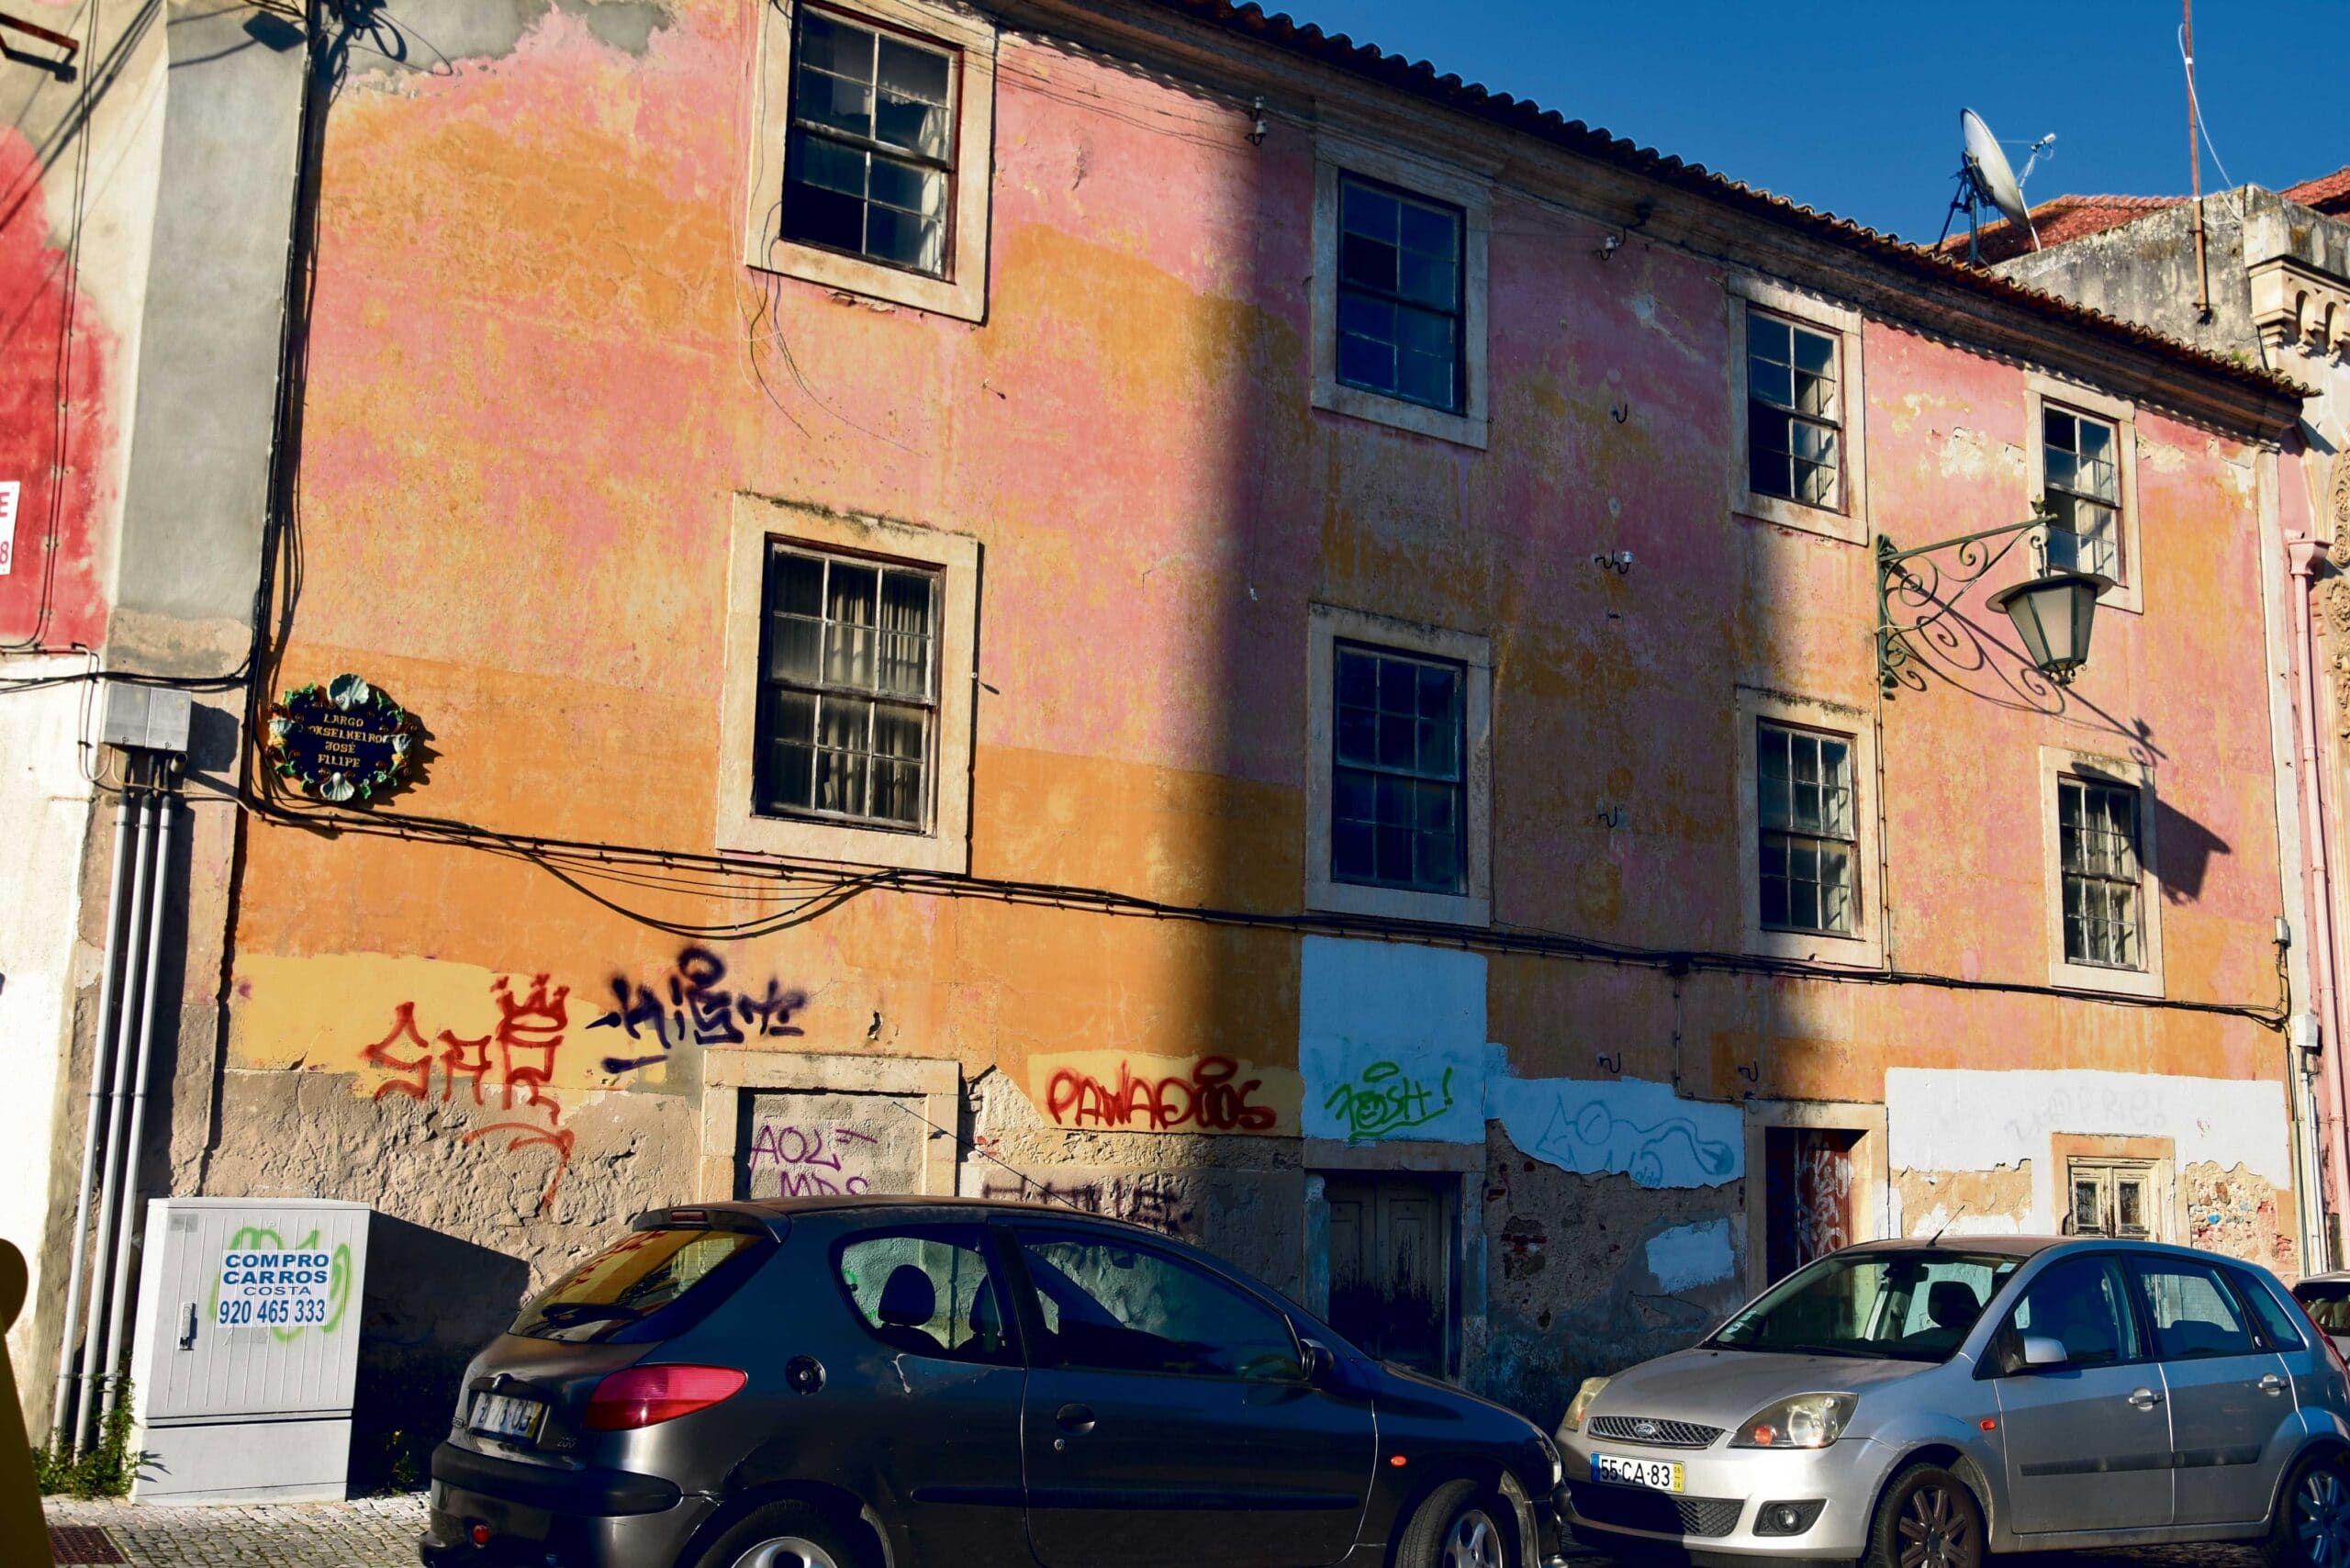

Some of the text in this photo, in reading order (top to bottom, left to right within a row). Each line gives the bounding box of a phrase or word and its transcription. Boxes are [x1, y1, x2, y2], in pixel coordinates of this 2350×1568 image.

[323, 713, 364, 727] LARGO
[325, 741, 356, 754] JOSÉ
[318, 754, 360, 767] FILIPE
[225, 1254, 330, 1269] COMPRO
[223, 1271, 328, 1284] CARROS
[243, 1286, 311, 1295] COSTA
[218, 1299, 326, 1324] 920 465 333
